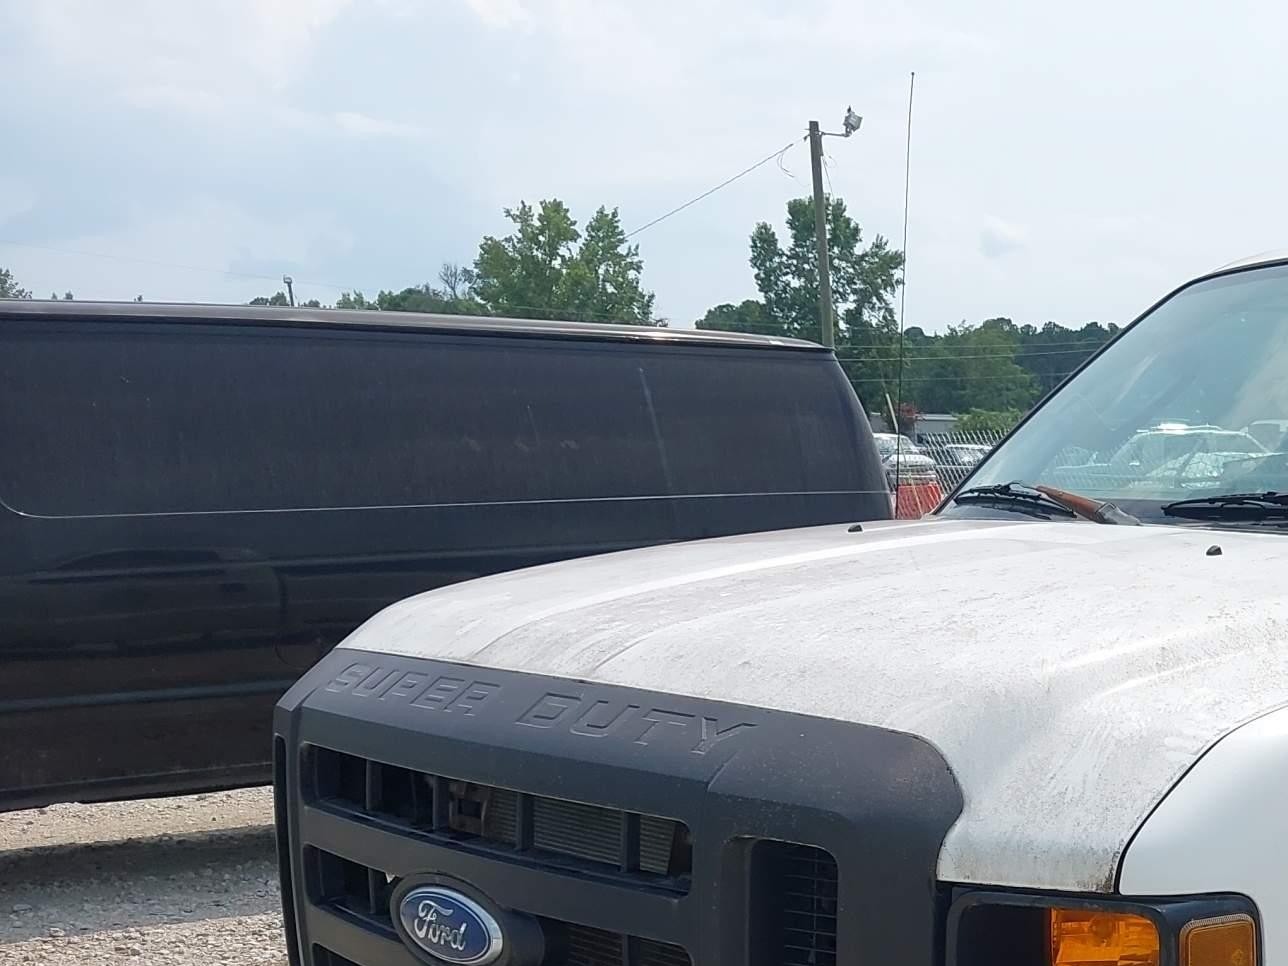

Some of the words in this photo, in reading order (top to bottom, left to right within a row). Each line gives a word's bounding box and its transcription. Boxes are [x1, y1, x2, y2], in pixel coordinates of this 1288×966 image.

[324, 662, 502, 717] SUPER
[515, 691, 758, 755] DUTY
[414, 900, 468, 951] Ford
